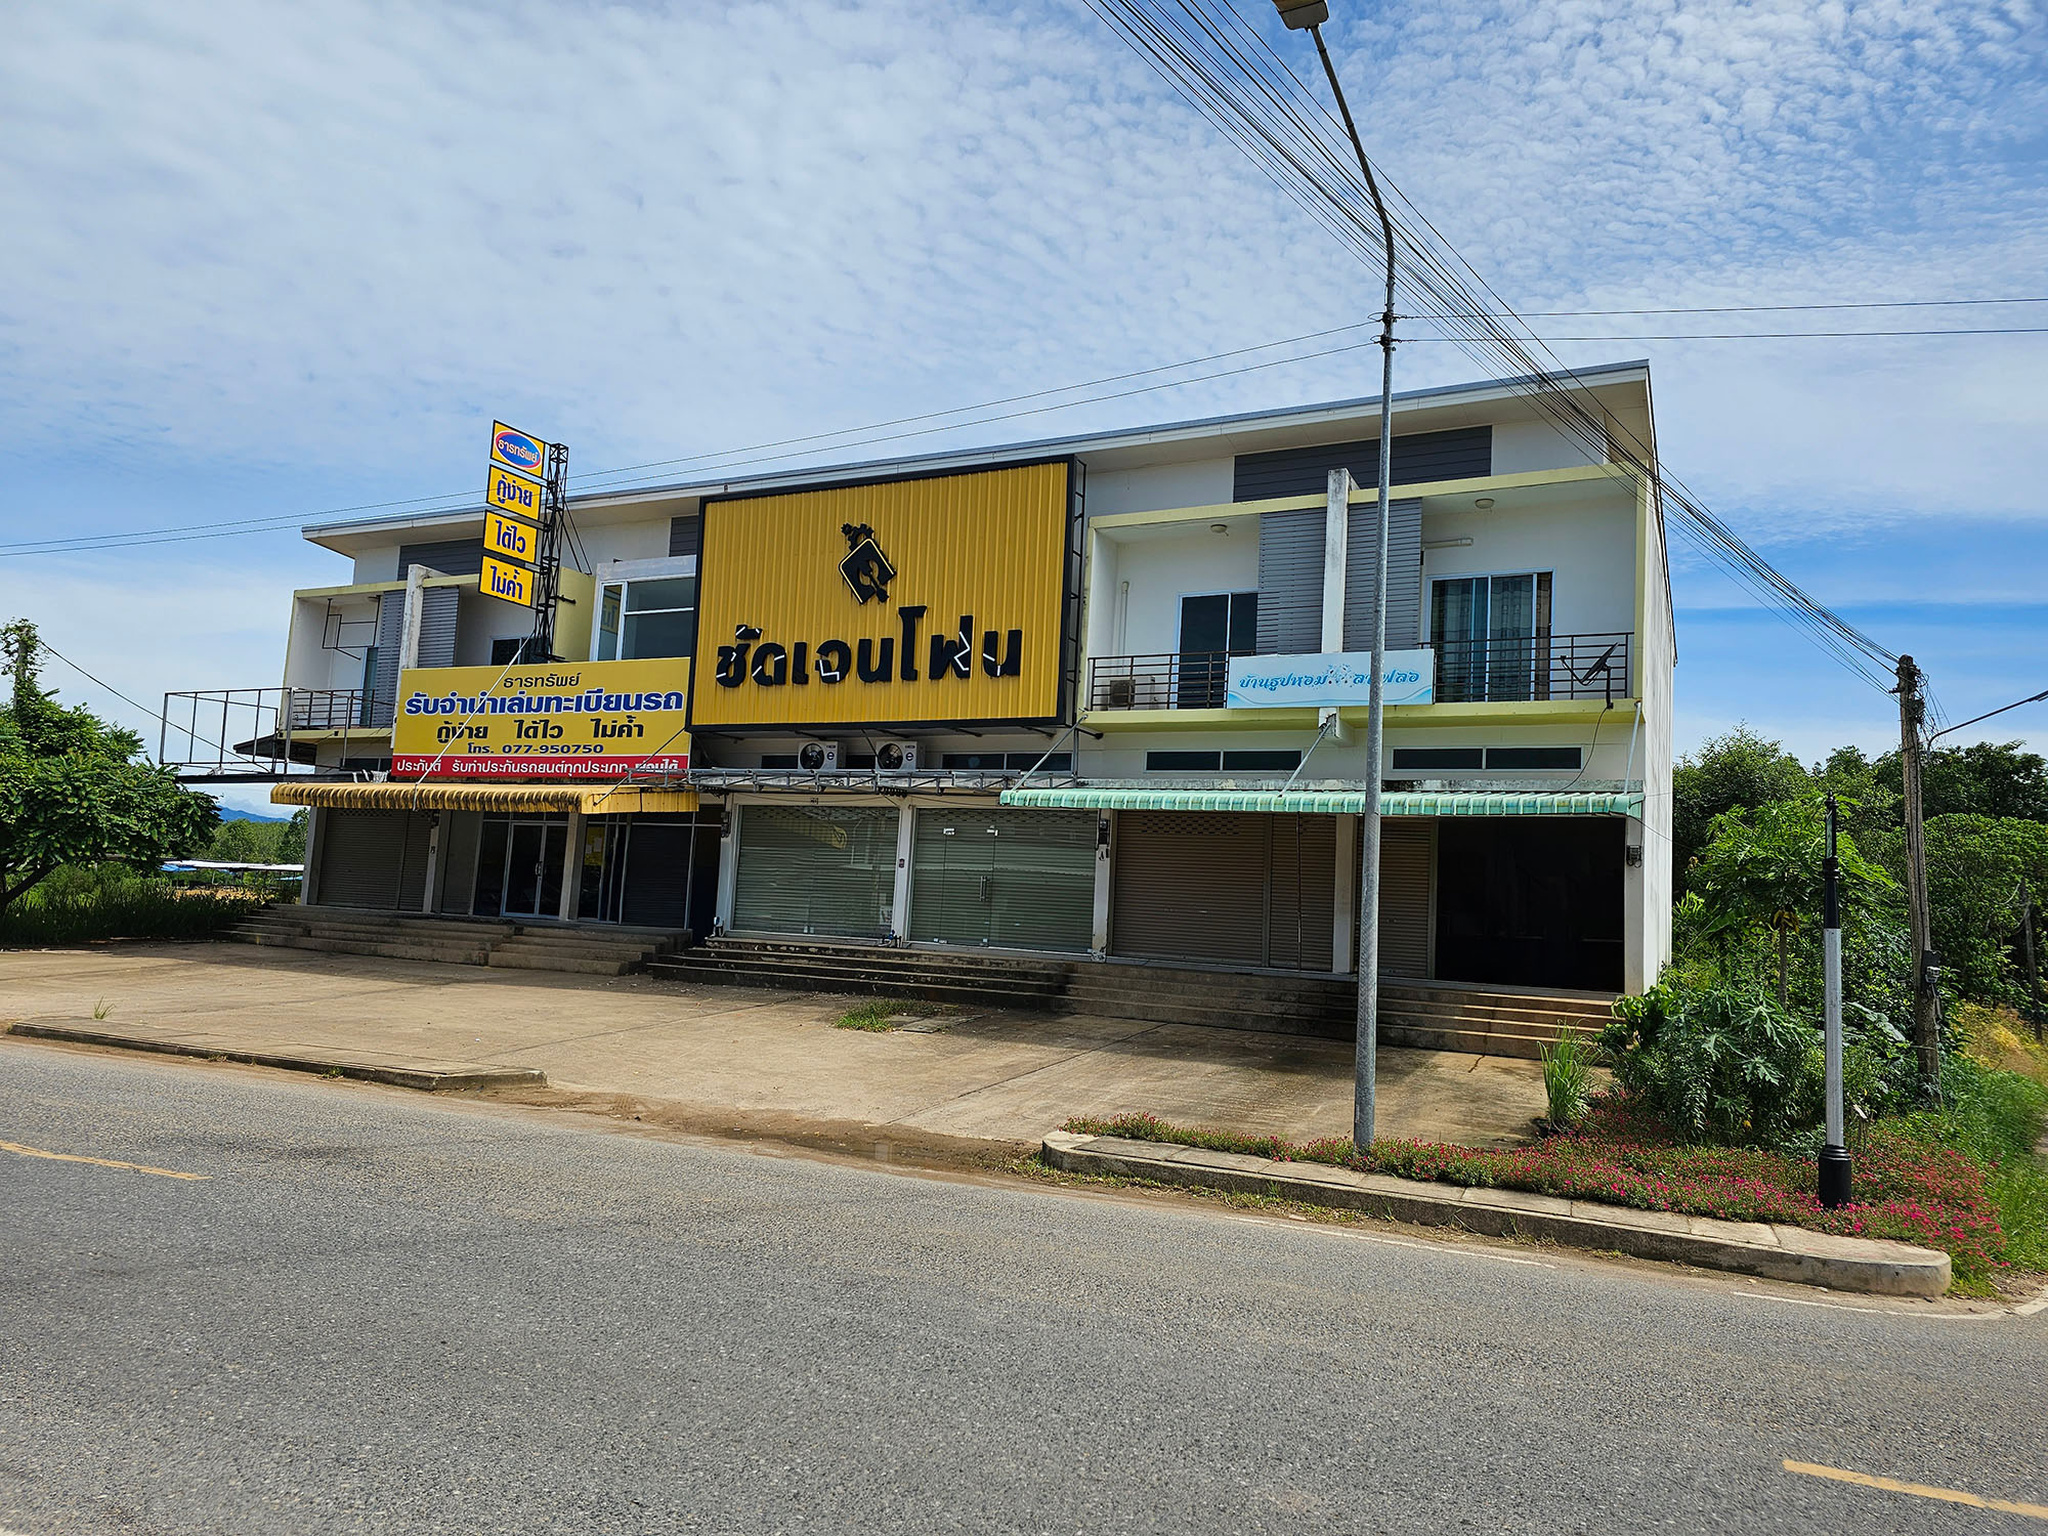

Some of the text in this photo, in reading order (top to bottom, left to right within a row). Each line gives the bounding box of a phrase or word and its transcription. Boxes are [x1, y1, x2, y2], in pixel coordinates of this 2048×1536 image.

[497, 474, 533, 508] กู้ง่าย
[495, 520, 526, 554] ได้ไว
[490, 566, 523, 600] ไม่ค้ำ
[503, 672, 581, 689] ธารทรัพย์
[405, 688, 684, 714] รับจำนำเล่มทะเบียนรถ
[436, 715, 644, 744] กู้ง่าย ได้ไว ไม่ค้ำ
[467, 743, 604, 754] โทร. 077-950750
[397, 759, 442, 773] ประกันดี
[452, 757, 628, 777] รับทำประกันรถยนต์ทุกประเภท
